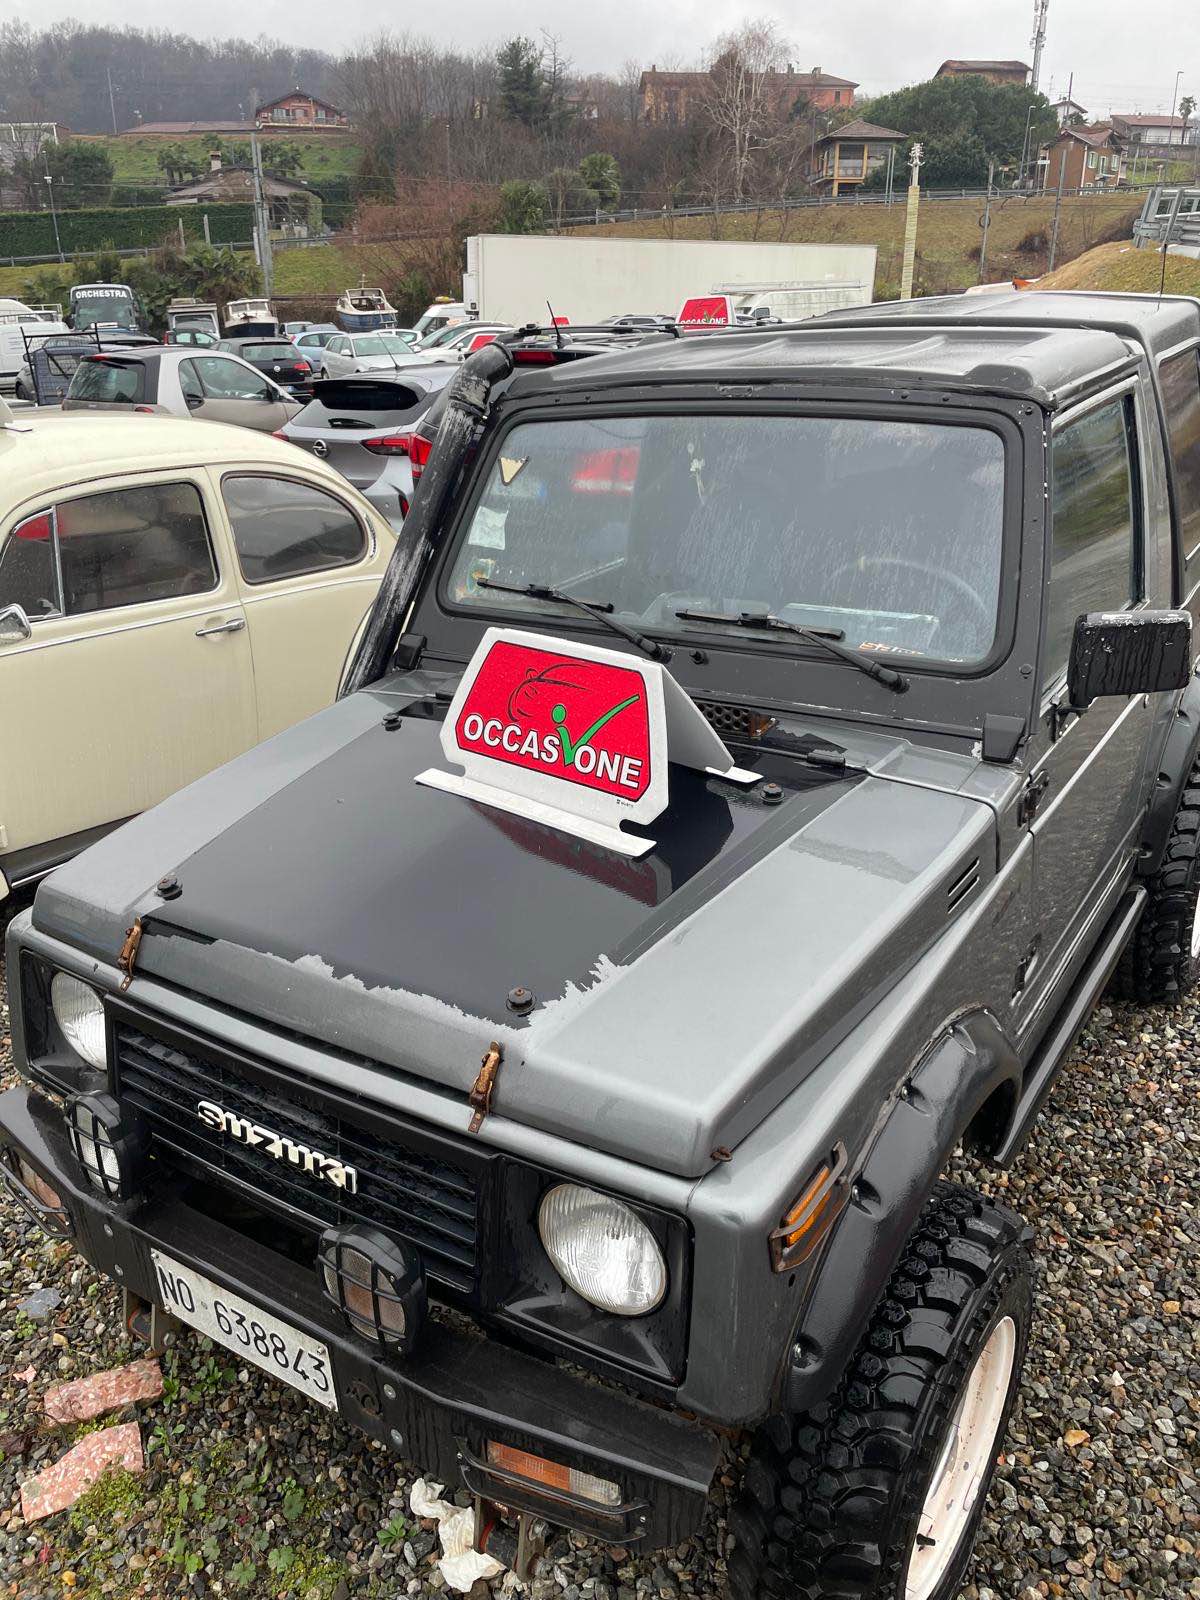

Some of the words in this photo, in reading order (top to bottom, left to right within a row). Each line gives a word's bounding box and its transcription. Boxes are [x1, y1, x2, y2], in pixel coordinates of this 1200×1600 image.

[75, 289, 128, 299] ORCHESTRA
[463, 704, 643, 790] OCCASIONE
[197, 1100, 358, 1195] SUZUKI
[157, 1265, 196, 1313] NO
[213, 1299, 329, 1392] 638843
